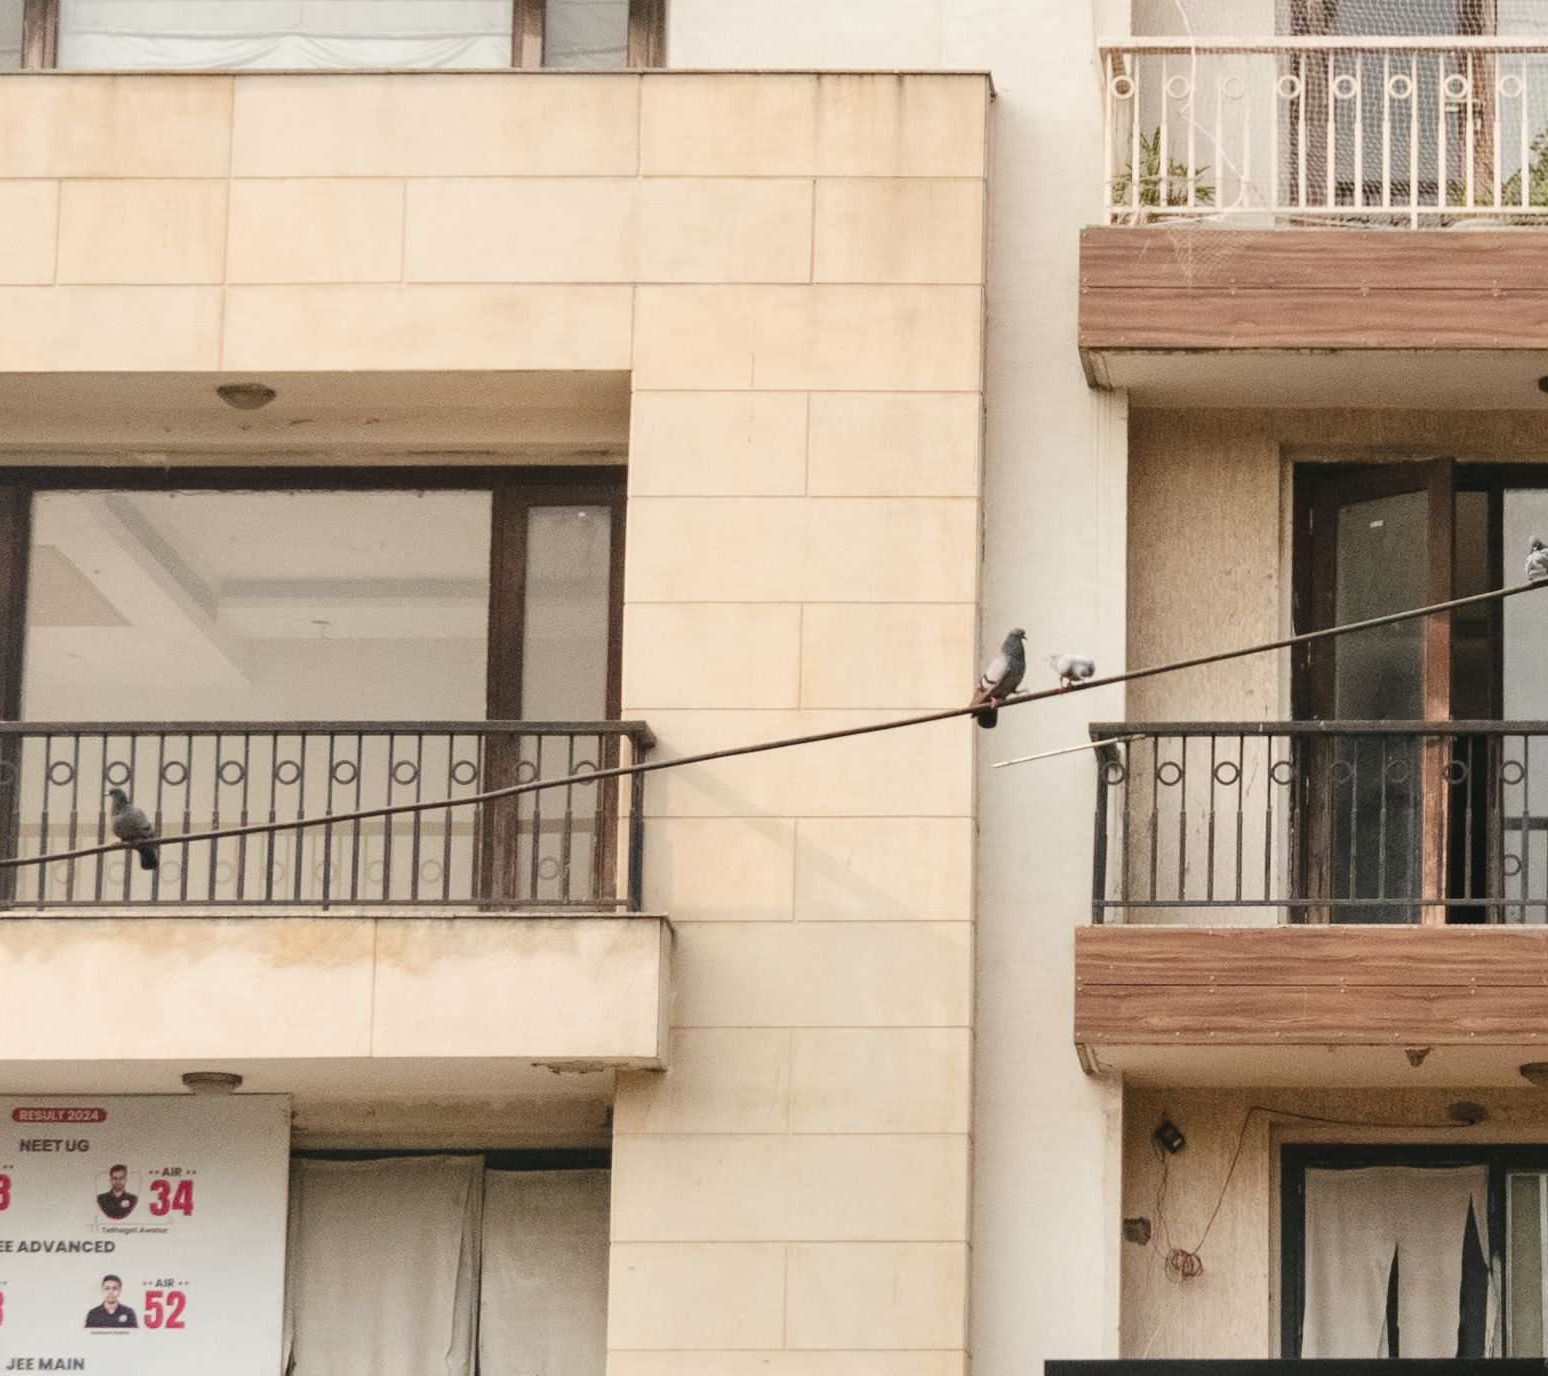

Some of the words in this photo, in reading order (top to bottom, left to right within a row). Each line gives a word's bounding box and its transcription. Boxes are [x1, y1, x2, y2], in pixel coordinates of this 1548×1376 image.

[19, 1110, 65, 1122] RESULT
[68, 1110, 99, 1122] 2024
[19, 1139, 63, 1153] NEET
[66, 1139, 90, 1153] UG
[161, 1167, 182, 1177] AIR
[149, 1179, 194, 1217] 34
[17, 1240, 116, 1253] ADVANCED
[155, 1278, 174, 1288] AIR
[144, 1290, 187, 1329] 52
[6, 1358, 35, 1371] JEE
[38, 1358, 85, 1371] MAIN
